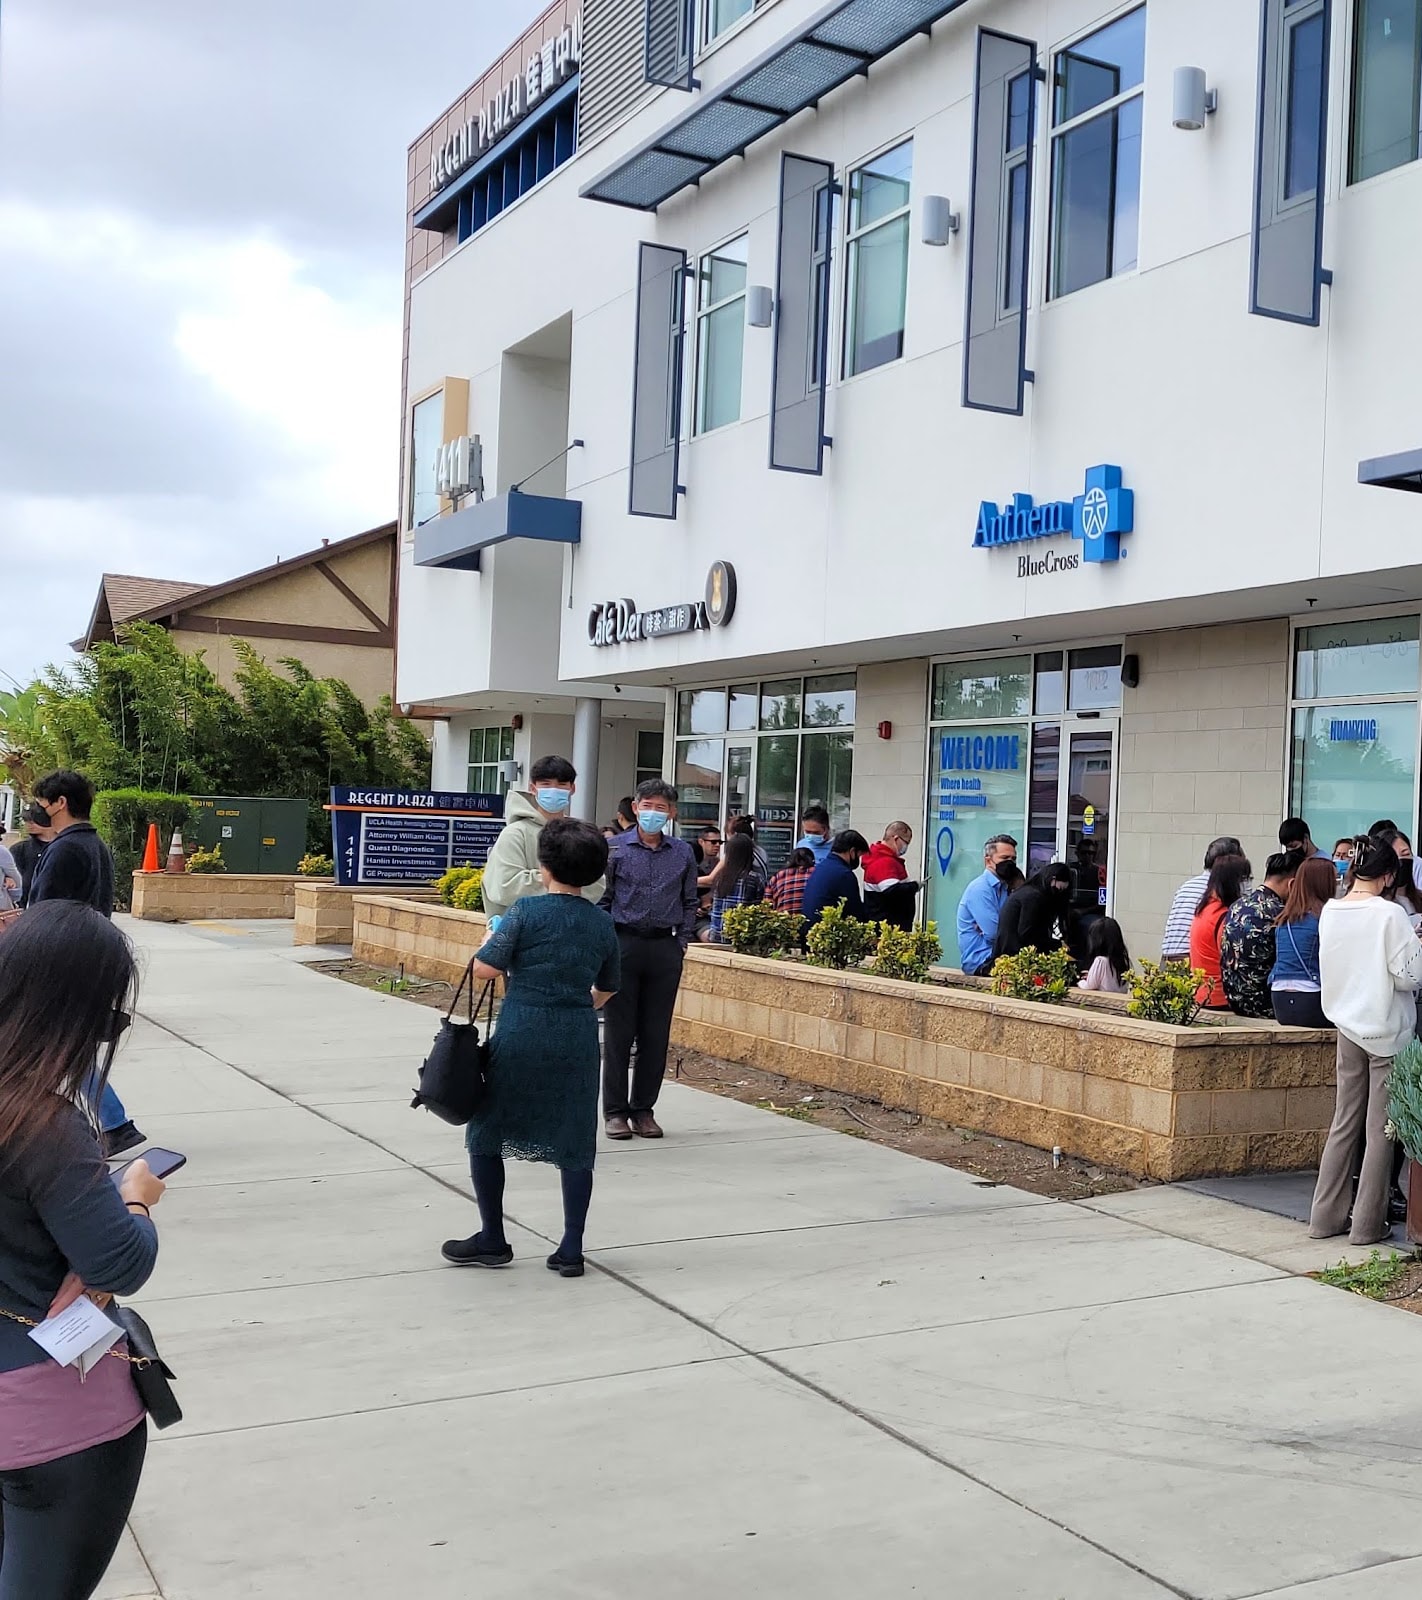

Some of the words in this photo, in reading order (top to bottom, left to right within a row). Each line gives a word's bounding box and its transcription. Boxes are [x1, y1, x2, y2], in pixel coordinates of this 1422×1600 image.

[429, 116, 477, 191] REGENT
[479, 73, 523, 149] PLAZA
[972, 493, 1070, 547] Anthem
[1016, 550, 1079, 578] BlueCross
[941, 735, 1019, 770] WELCOME
[961, 777, 981, 791] health
[347, 791, 395, 806] REGENT
[397, 794, 434, 807] PLAZA
[368, 832, 397, 840] Attorney
[399, 832, 424, 840] William
[425, 834, 445, 842] Kiang
[455, 835, 491, 843] University
[391, 845, 435, 853] Diagnostics
[391, 858, 436, 866] Investments
[377, 870, 404, 879] Property
